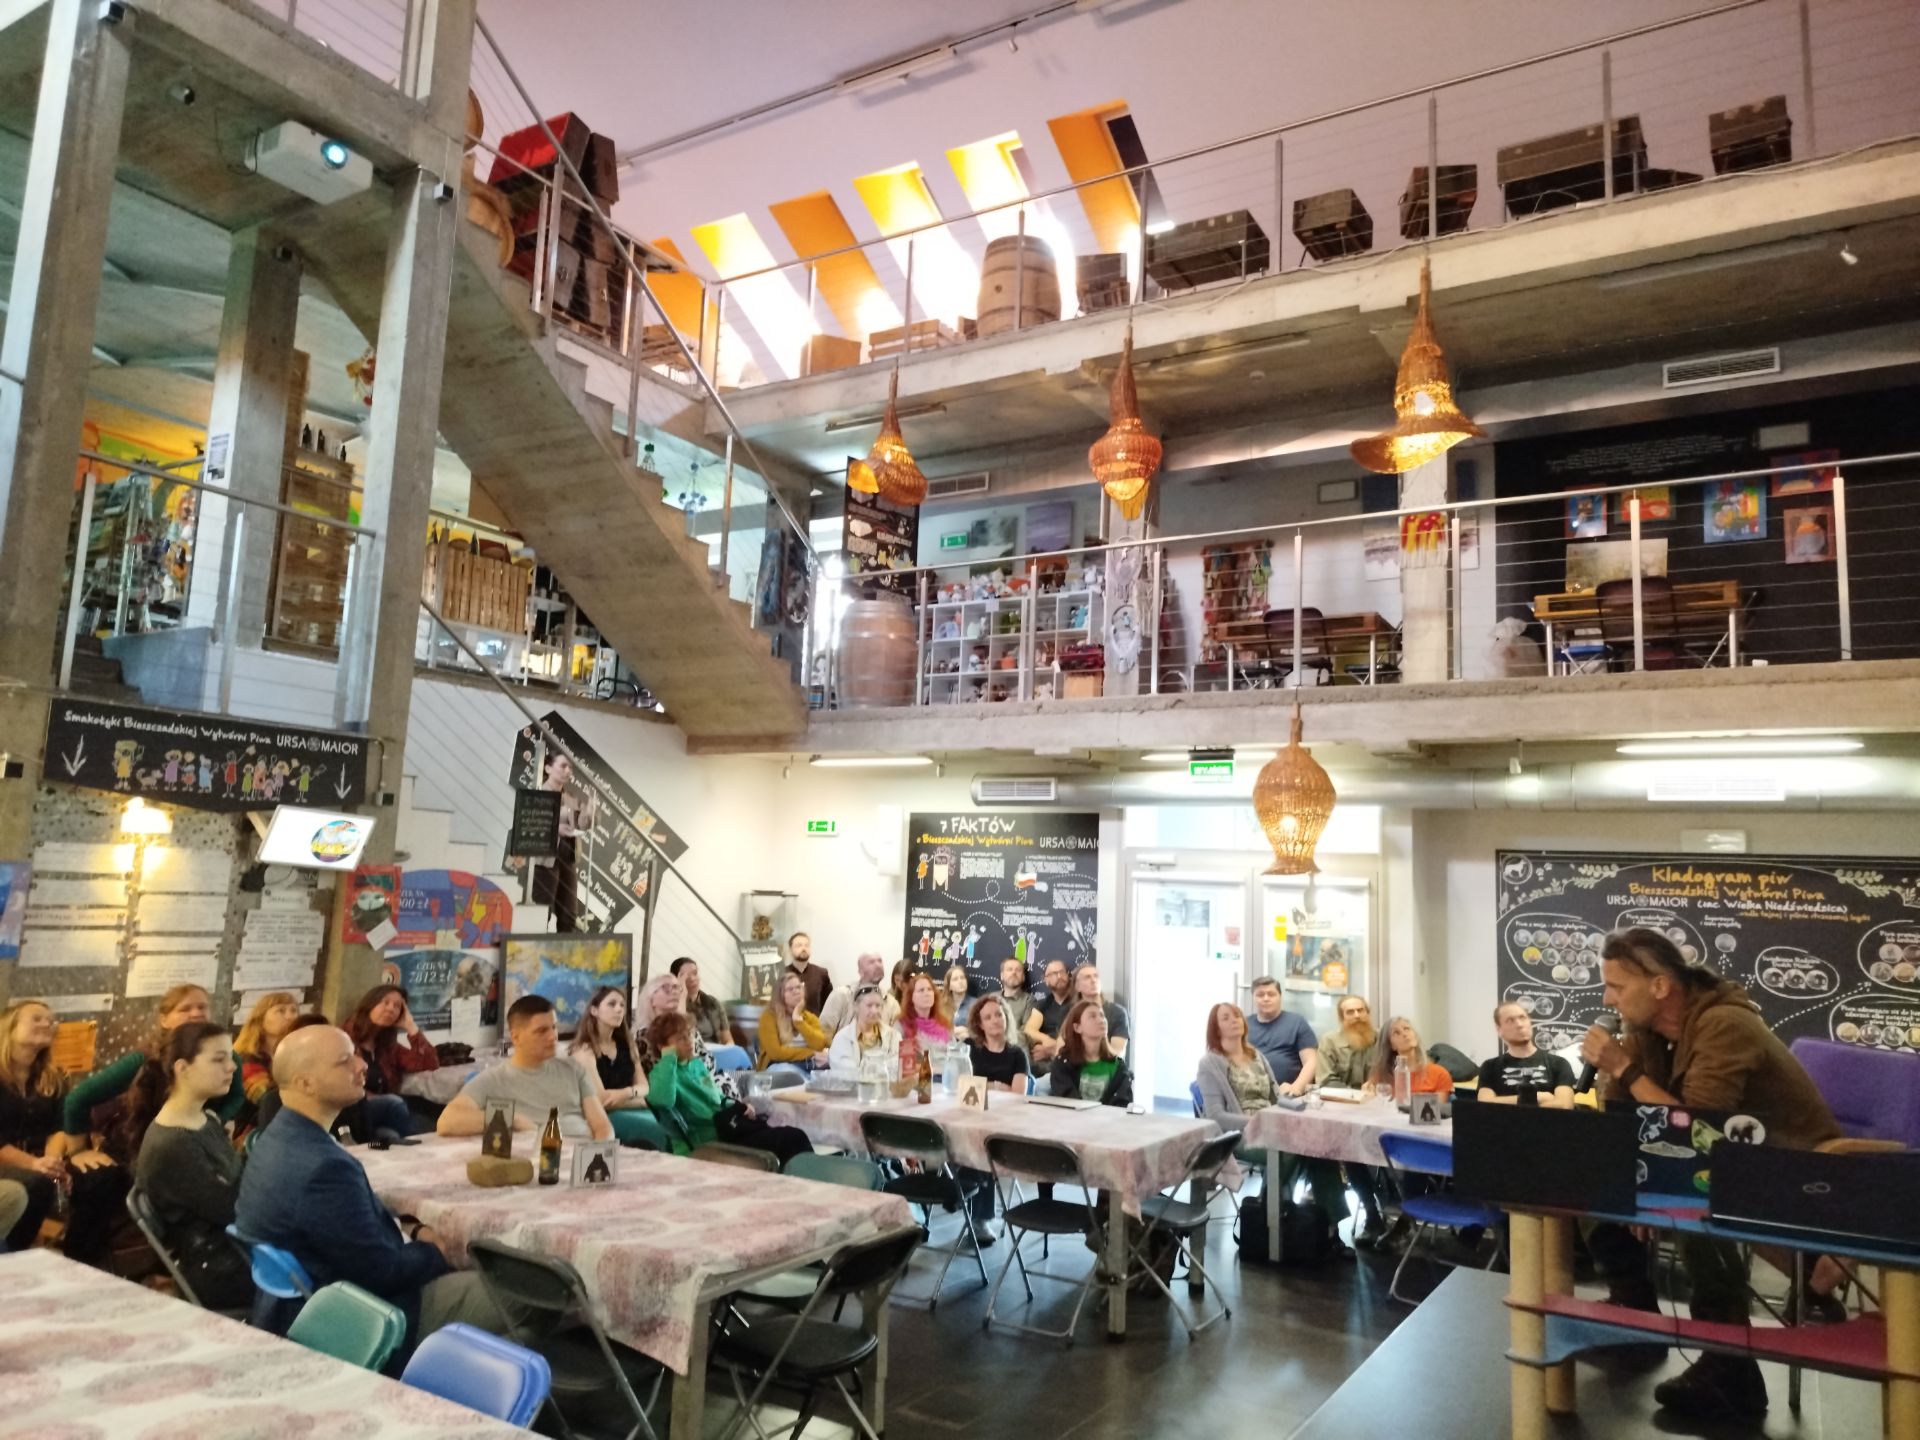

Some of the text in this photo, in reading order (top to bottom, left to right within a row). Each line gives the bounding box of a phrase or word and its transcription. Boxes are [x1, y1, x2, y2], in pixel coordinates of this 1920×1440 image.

[64, 710, 359, 756] Smakołyki Bieszczadzkiej Wytwórni Piwa URSA MAIOR
[940, 815, 1016, 834] 7 FAKTÓW
[922, 833, 974, 847] Bieszczadzkiej
[1015, 835, 1034, 846] Piwa
[1039, 837, 1065, 849] URSA
[1077, 838, 1099, 850] MAI
[1652, 865, 1794, 891] Kladogram piw
[1628, 882, 1825, 901] Bieszczadzkiej Wytwórni Piwa
[1606, 894, 1636, 906] URSA
[1649, 896, 1689, 908] MAIOR
[1723, 898, 1762, 910] Wielka
